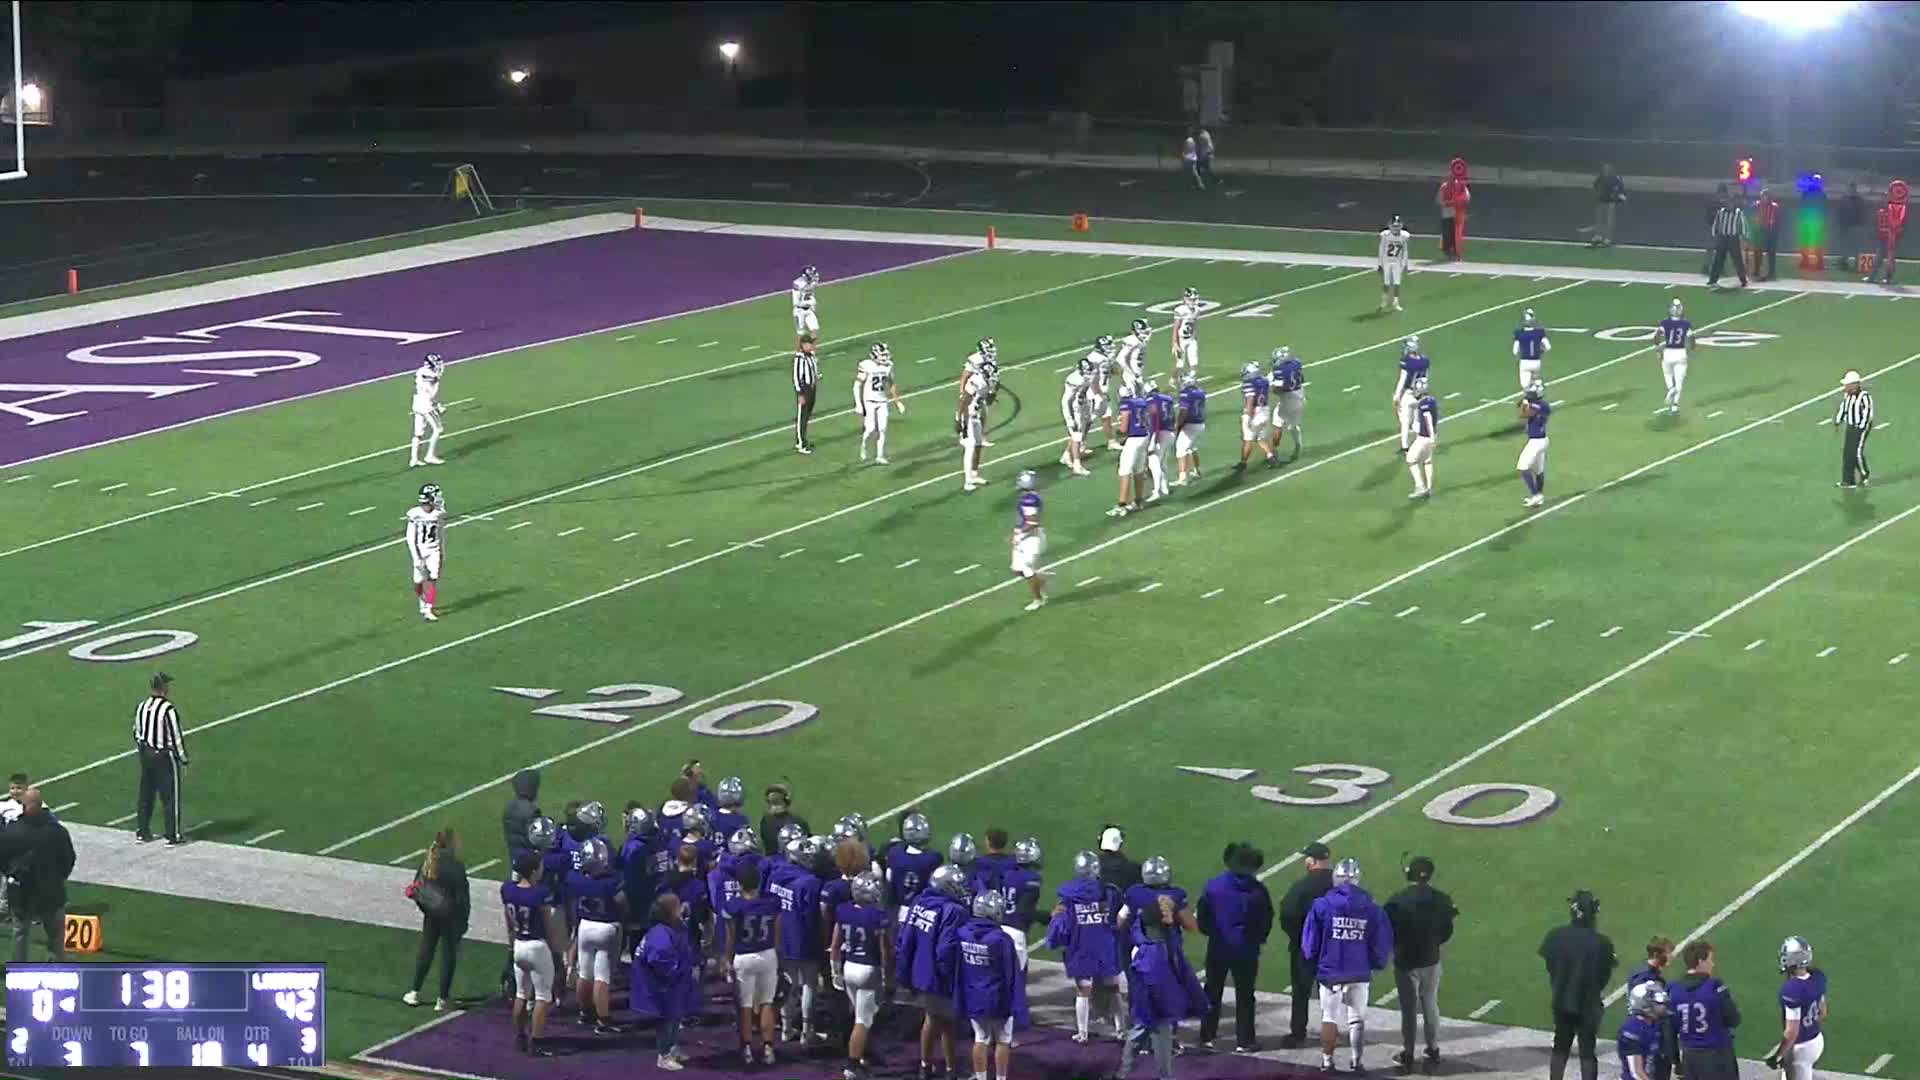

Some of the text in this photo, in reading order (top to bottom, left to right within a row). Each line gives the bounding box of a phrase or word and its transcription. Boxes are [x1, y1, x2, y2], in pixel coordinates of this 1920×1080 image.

[1739, 160, 1751, 180] 3
[1387, 244, 1402, 257] 27
[1668, 328, 1684, 344] 13
[422, 525, 437, 543] 14
[0, 620, 199, 662] 10
[531, 683, 820, 737] 20
[1250, 763, 1559, 826] 30
[1076, 912, 1110, 925] EAST
[65, 919, 92, 948] 20
[1332, 928, 1365, 940] EAST
